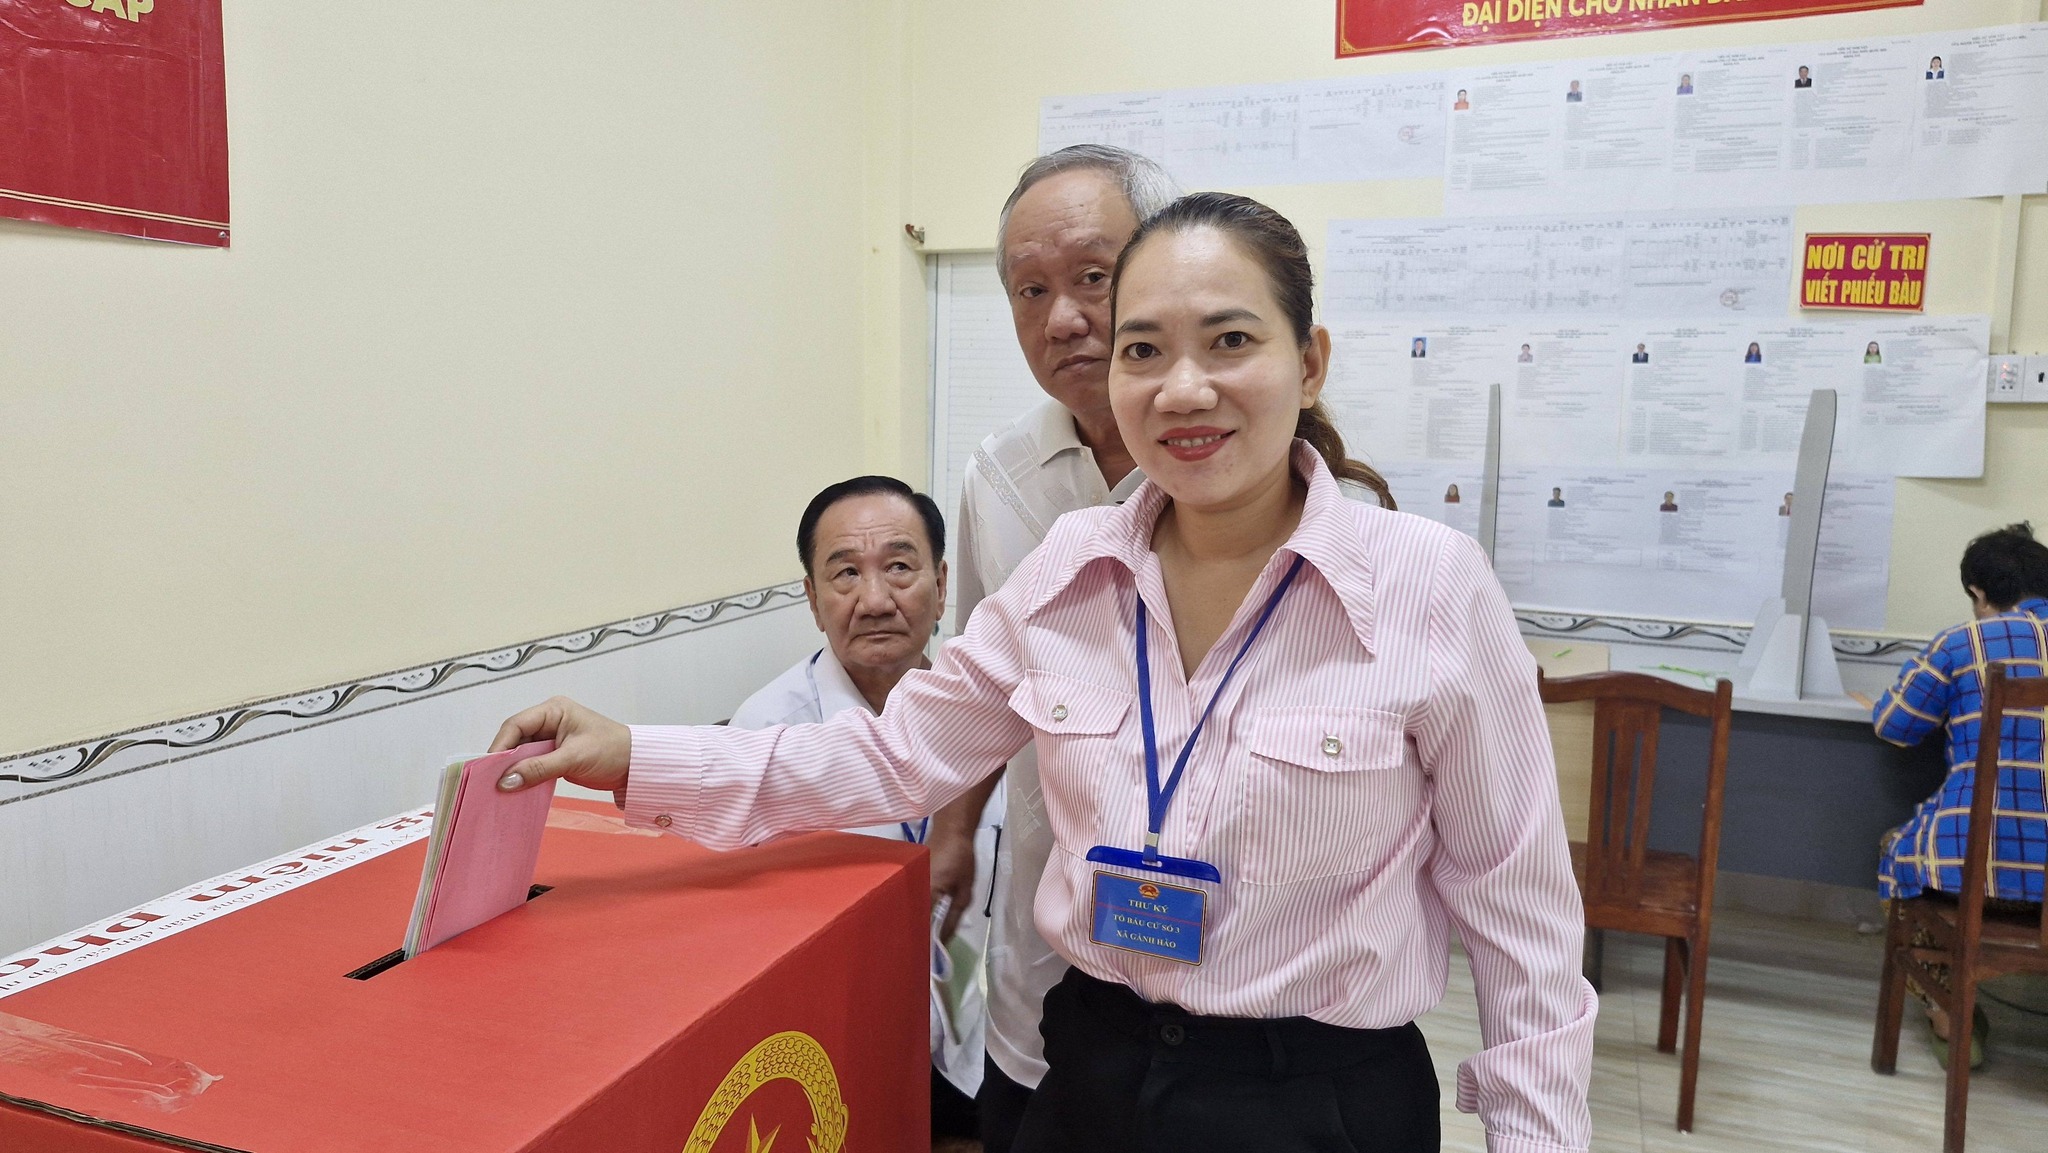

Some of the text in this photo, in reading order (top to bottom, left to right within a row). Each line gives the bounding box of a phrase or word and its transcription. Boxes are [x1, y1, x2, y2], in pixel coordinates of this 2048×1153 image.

[1462, 0, 1501, 32] ĐẠI
[1807, 239, 1926, 271] NƠI CỬ TRI
[1805, 272, 1838, 303] VIẾT
[1841, 272, 1886, 305] PHIẾU
[185, 838, 374, 902] niêm
[1128, 899, 1169, 914] THƯ KÝ
[159, 911, 206, 930] nhân
[116, 931, 153, 946] dân
[74, 947, 111, 962] các
[28, 963, 68, 979] cấp
